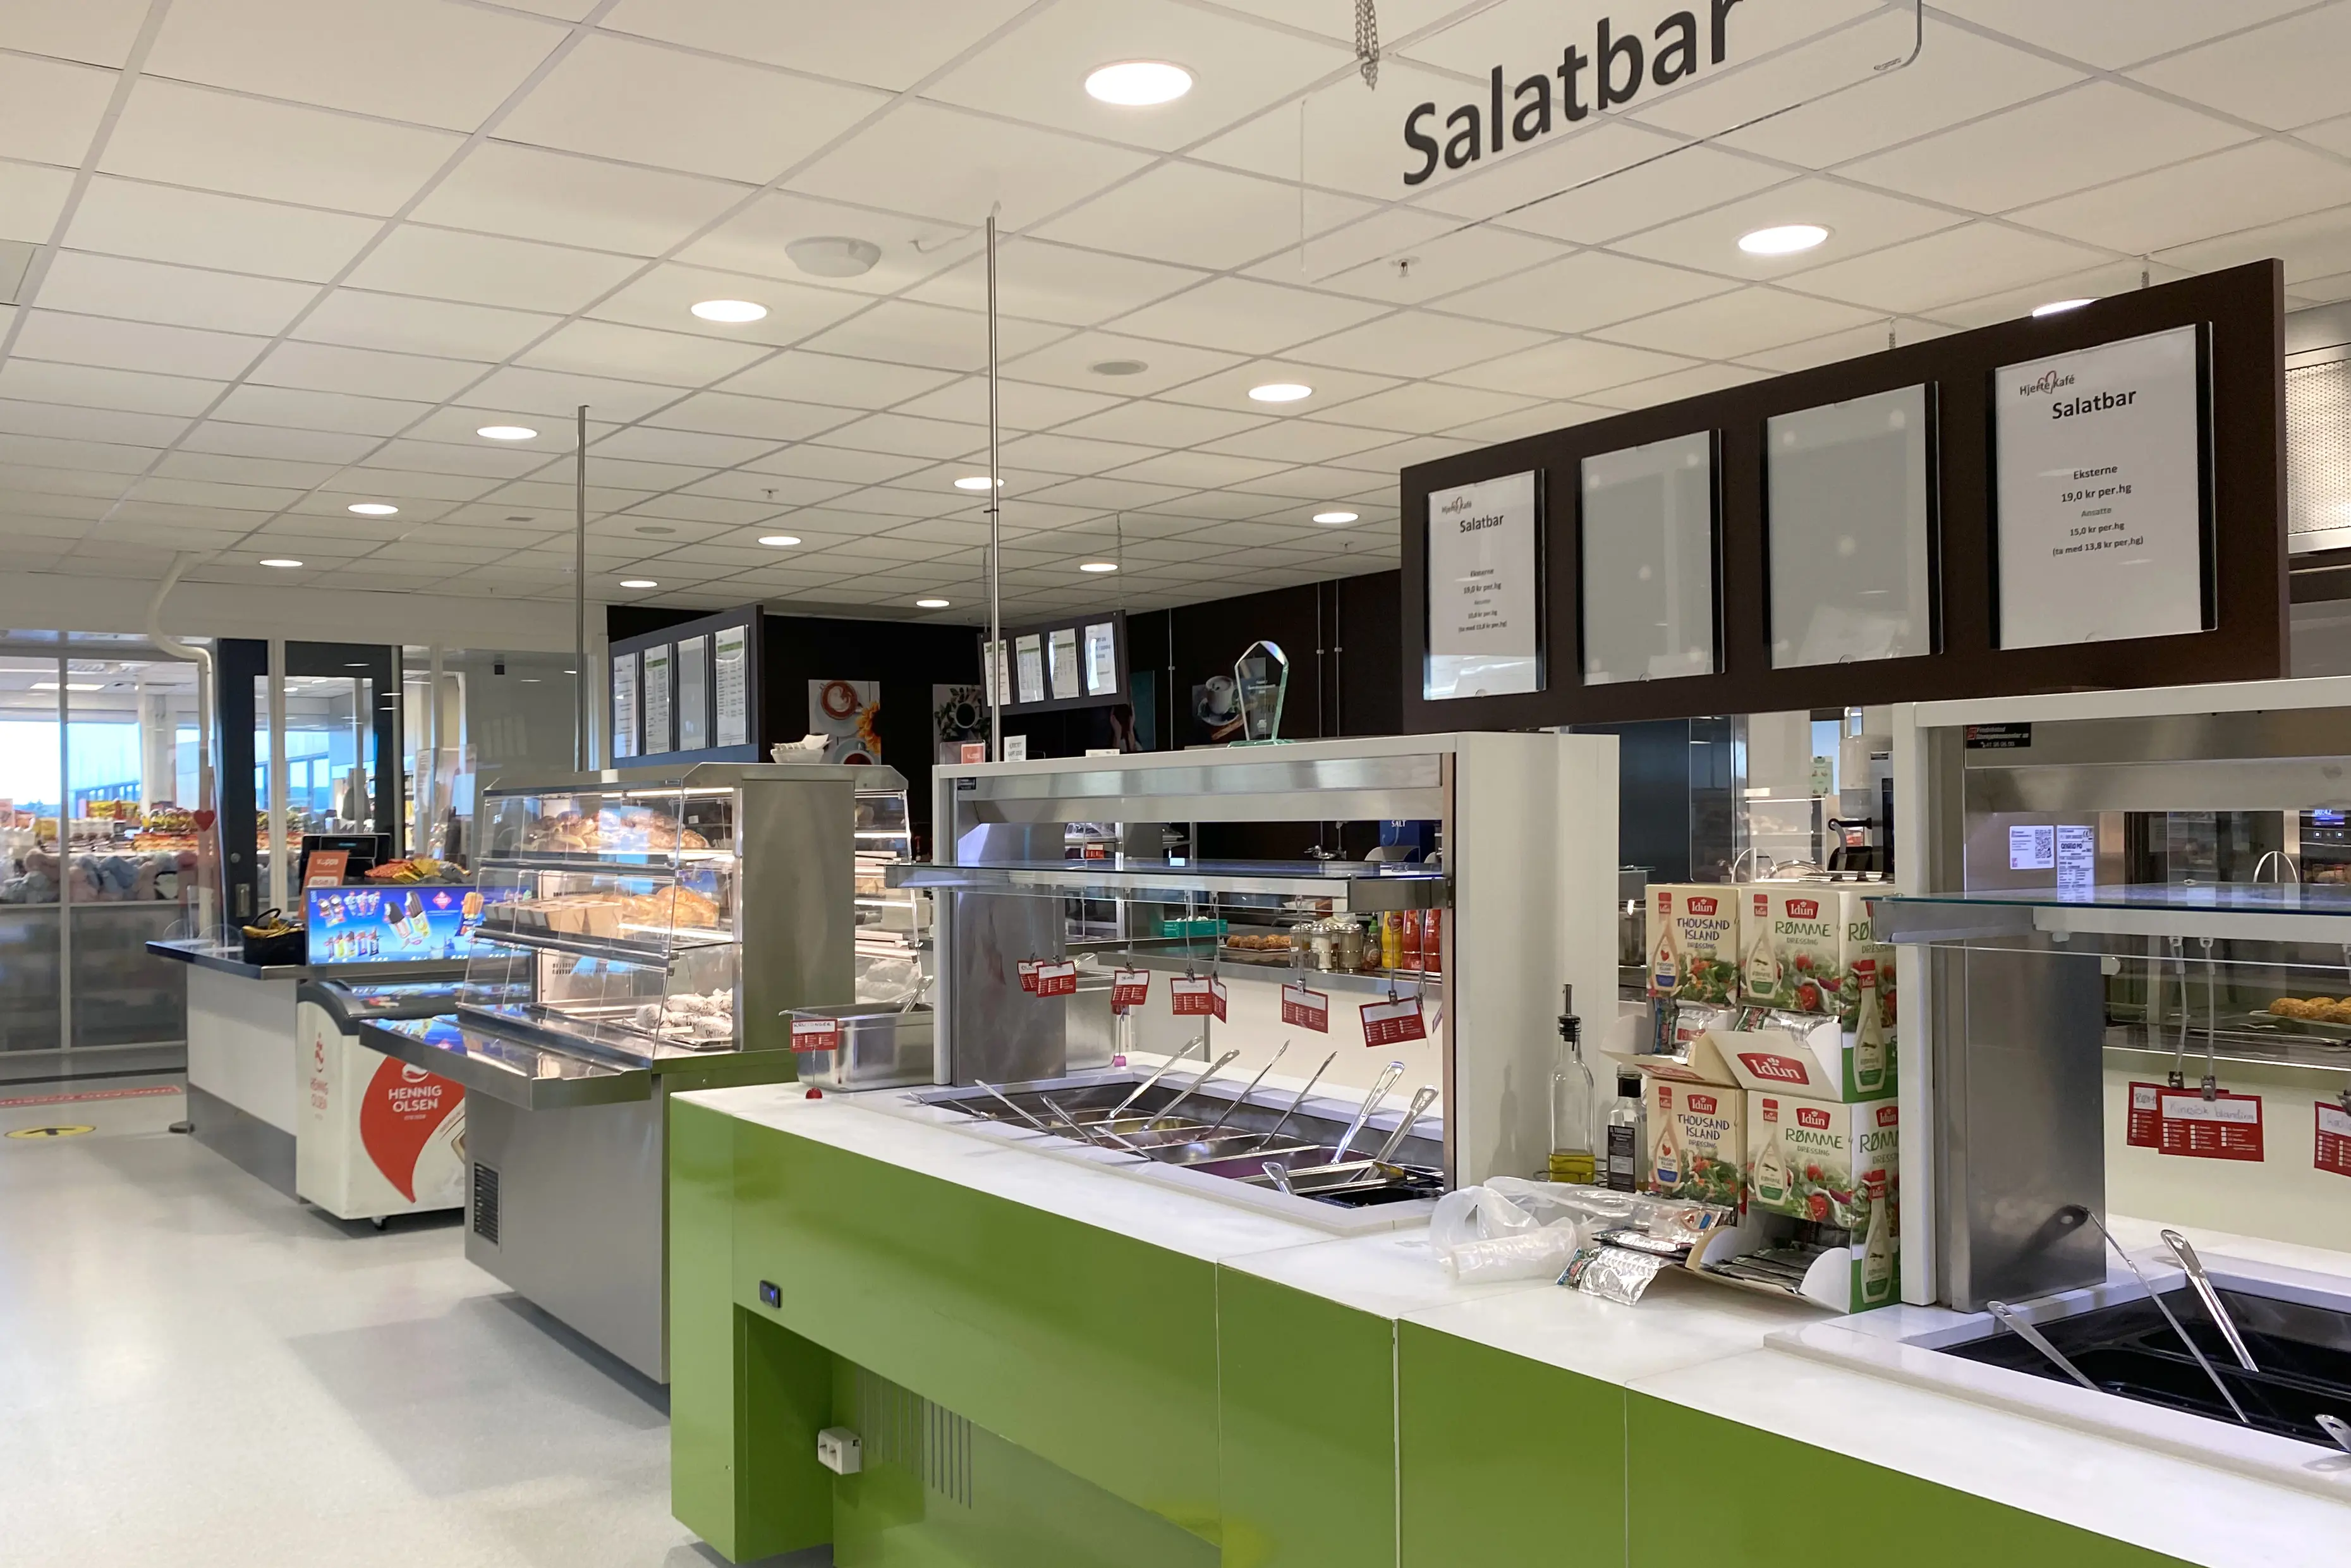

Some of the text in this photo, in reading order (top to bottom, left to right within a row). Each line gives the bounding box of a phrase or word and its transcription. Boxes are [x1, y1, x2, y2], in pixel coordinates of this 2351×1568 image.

[1404, 0, 1744, 186] Salatbar
[2020, 374, 2075, 396] Hjerte Kafé
[2052, 391, 2137, 420] Salatbar
[2074, 466, 2118, 480] Eksterne
[2062, 484, 2132, 502] 19,0 kr per.hg
[1460, 514, 1504, 533] Salatbar
[2070, 527, 2086, 536] 15,0
[2053, 547, 2063, 557] (ta
[2065, 544, 2083, 554] med
[2085, 542, 2102, 552] 13,8
[1691, 901, 1713, 913] Idun
[1790, 903, 1813, 916] Idun
[1676, 918, 1730, 930] THOUSAND
[1775, 921, 1831, 937] RØMME
[1684, 929, 1720, 941] ISLAND
[1787, 937, 1818, 945] DRESSING
[1750, 1059, 1802, 1080] Idun
[389, 1085, 442, 1100] HENNIG
[392, 1098, 438, 1112] OLSEN
[1692, 1098, 1713, 1112] Idun
[1677, 1114, 1730, 1130] THOUSAND
[1802, 1112, 1825, 1127] Idun
[1880, 1111, 1897, 1124] Idun
[1686, 1126, 1720, 1140] ISLAND
[1785, 1128, 1844, 1150] RØMME
[1689, 1140, 1717, 1149] DRESSING
[1797, 1145, 1830, 1157] DRESSING
